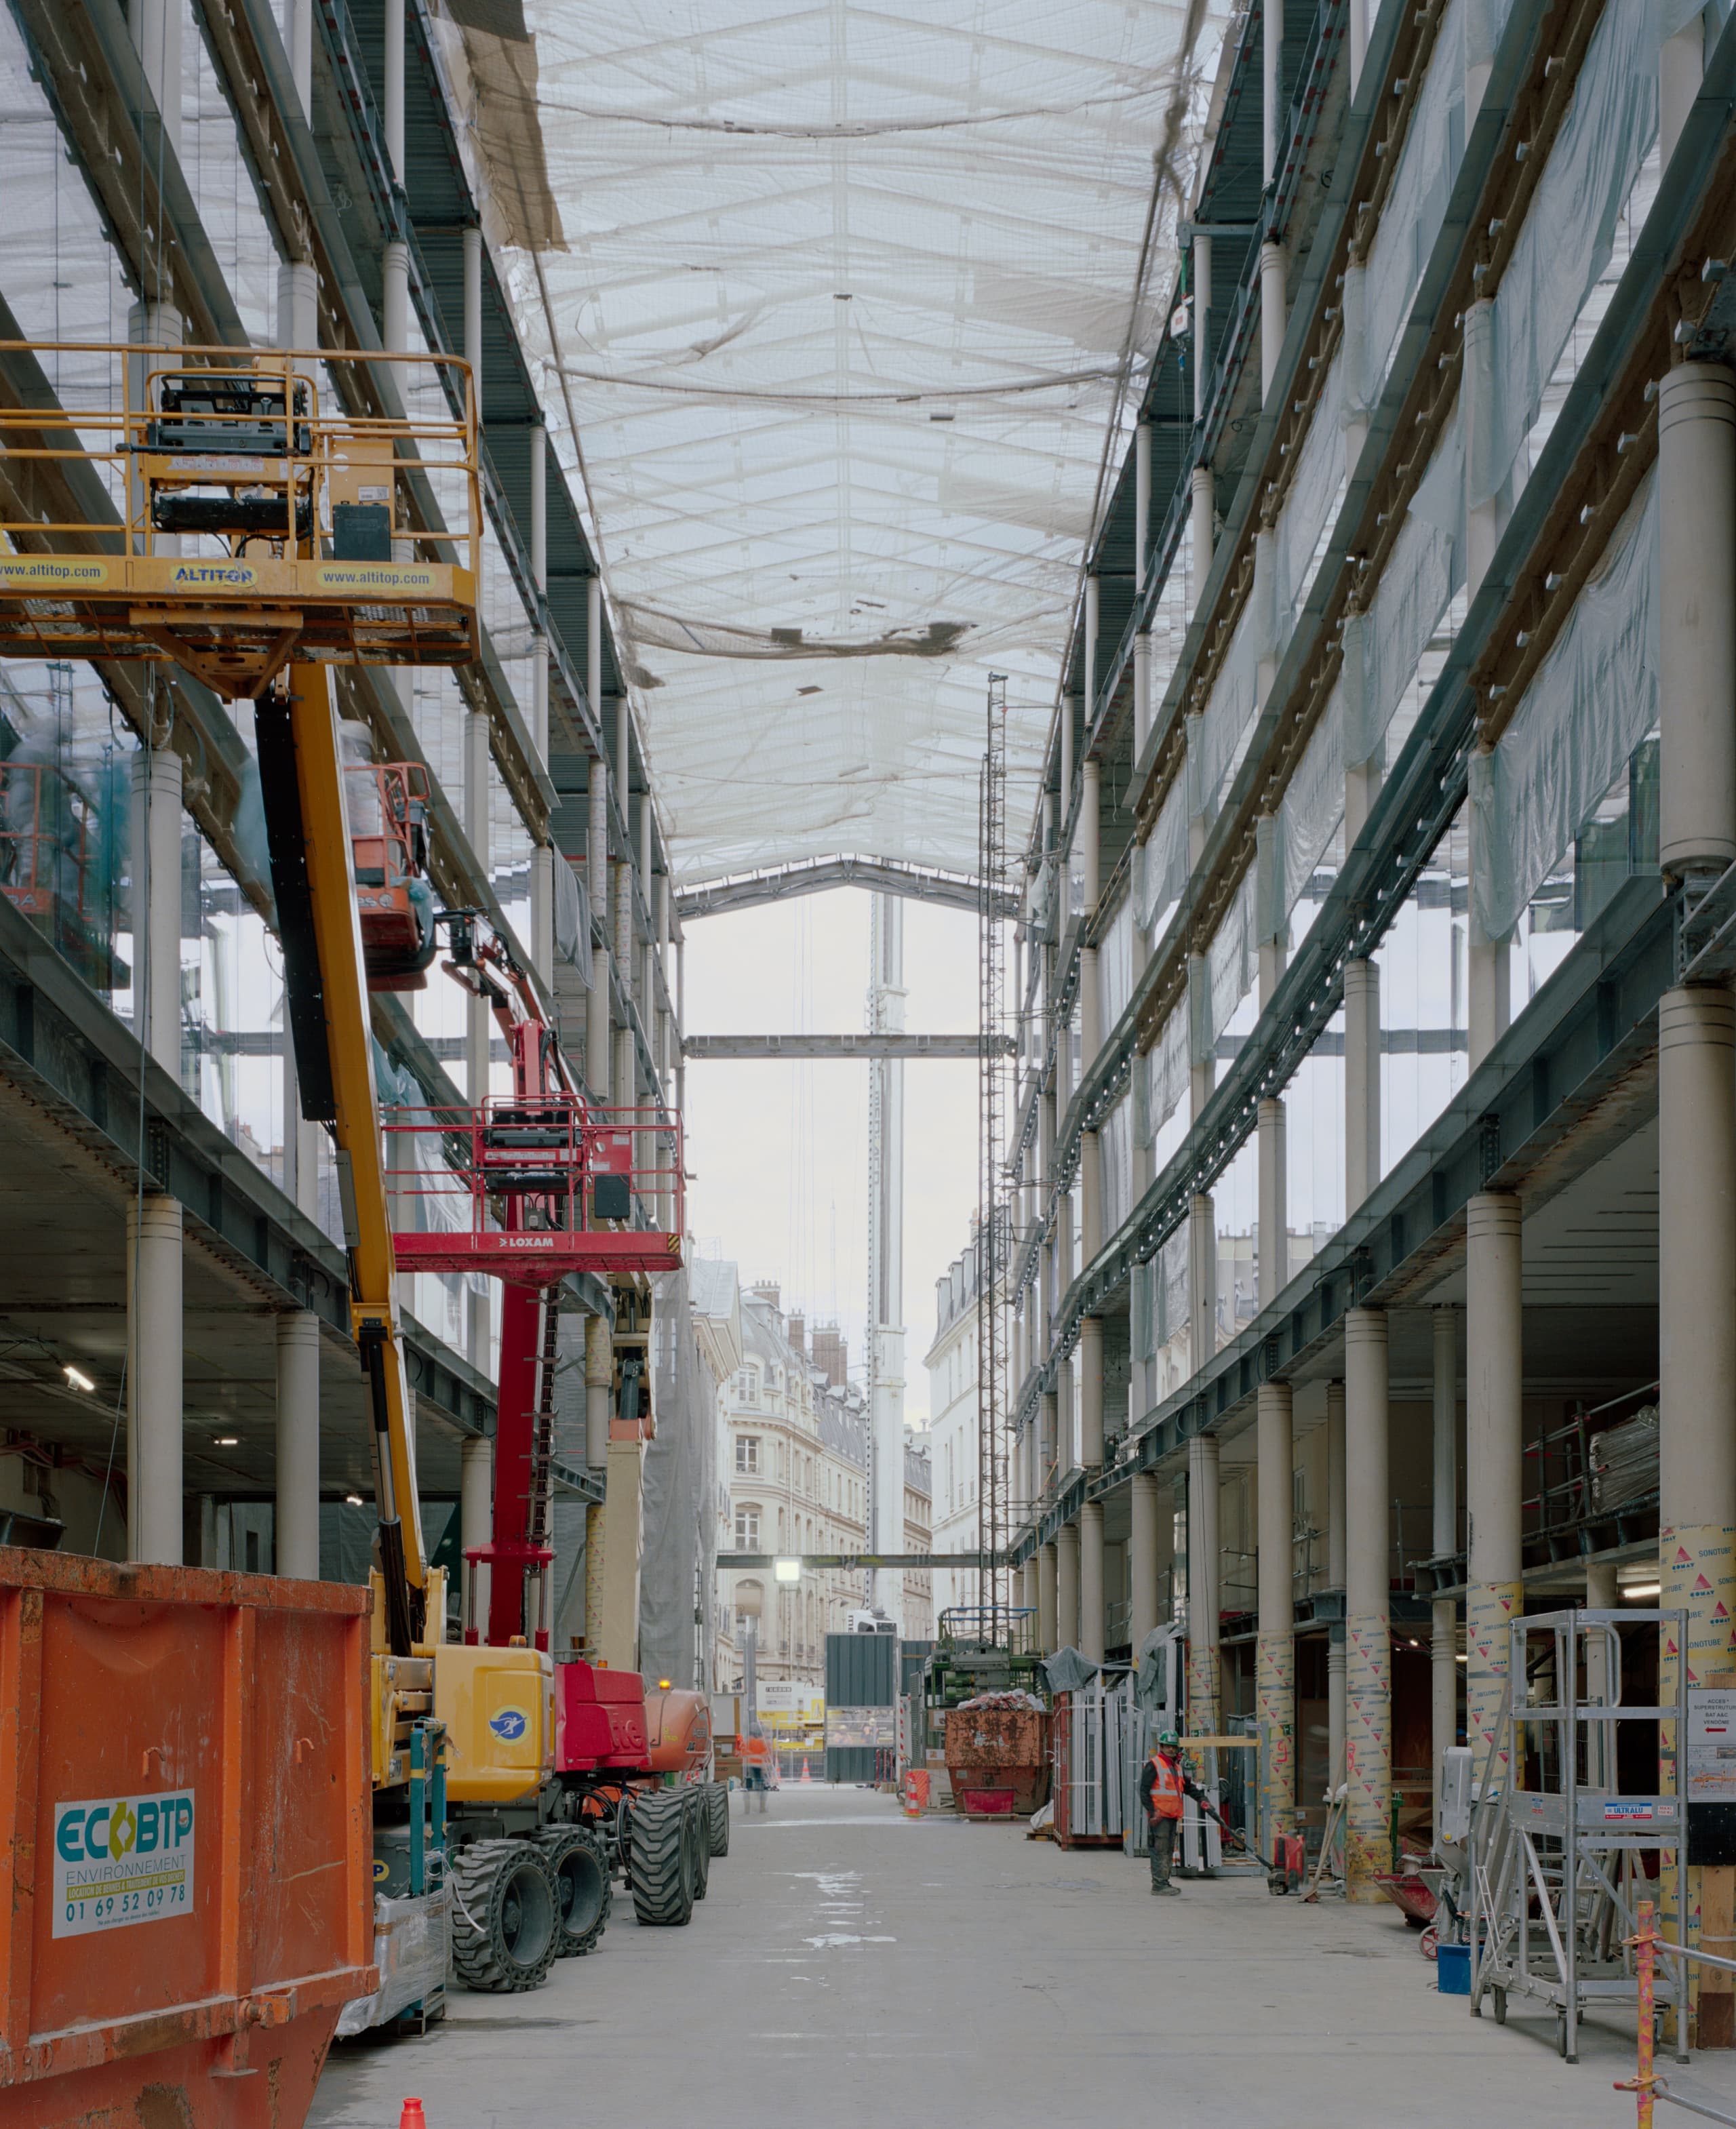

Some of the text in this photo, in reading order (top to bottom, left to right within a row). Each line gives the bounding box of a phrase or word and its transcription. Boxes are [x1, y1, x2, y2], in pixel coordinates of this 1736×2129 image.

[176, 568, 252, 582] ALTITOP
[323, 572, 430, 586] www.altitop.com
[509, 1237, 553, 1247] LOXAM
[1699, 1547, 1731, 1557] SONOTUBE
[66, 1854, 186, 1886] ENVIRONNEMENT
[69, 1885, 94, 1898] LOCATION
[95, 1884, 102, 1895] DE
[126, 1877, 152, 1890] TRAITEMENT
[159, 1874, 168, 1884] VOS
[66, 1884, 184, 1922] 01 69 52 09 78
